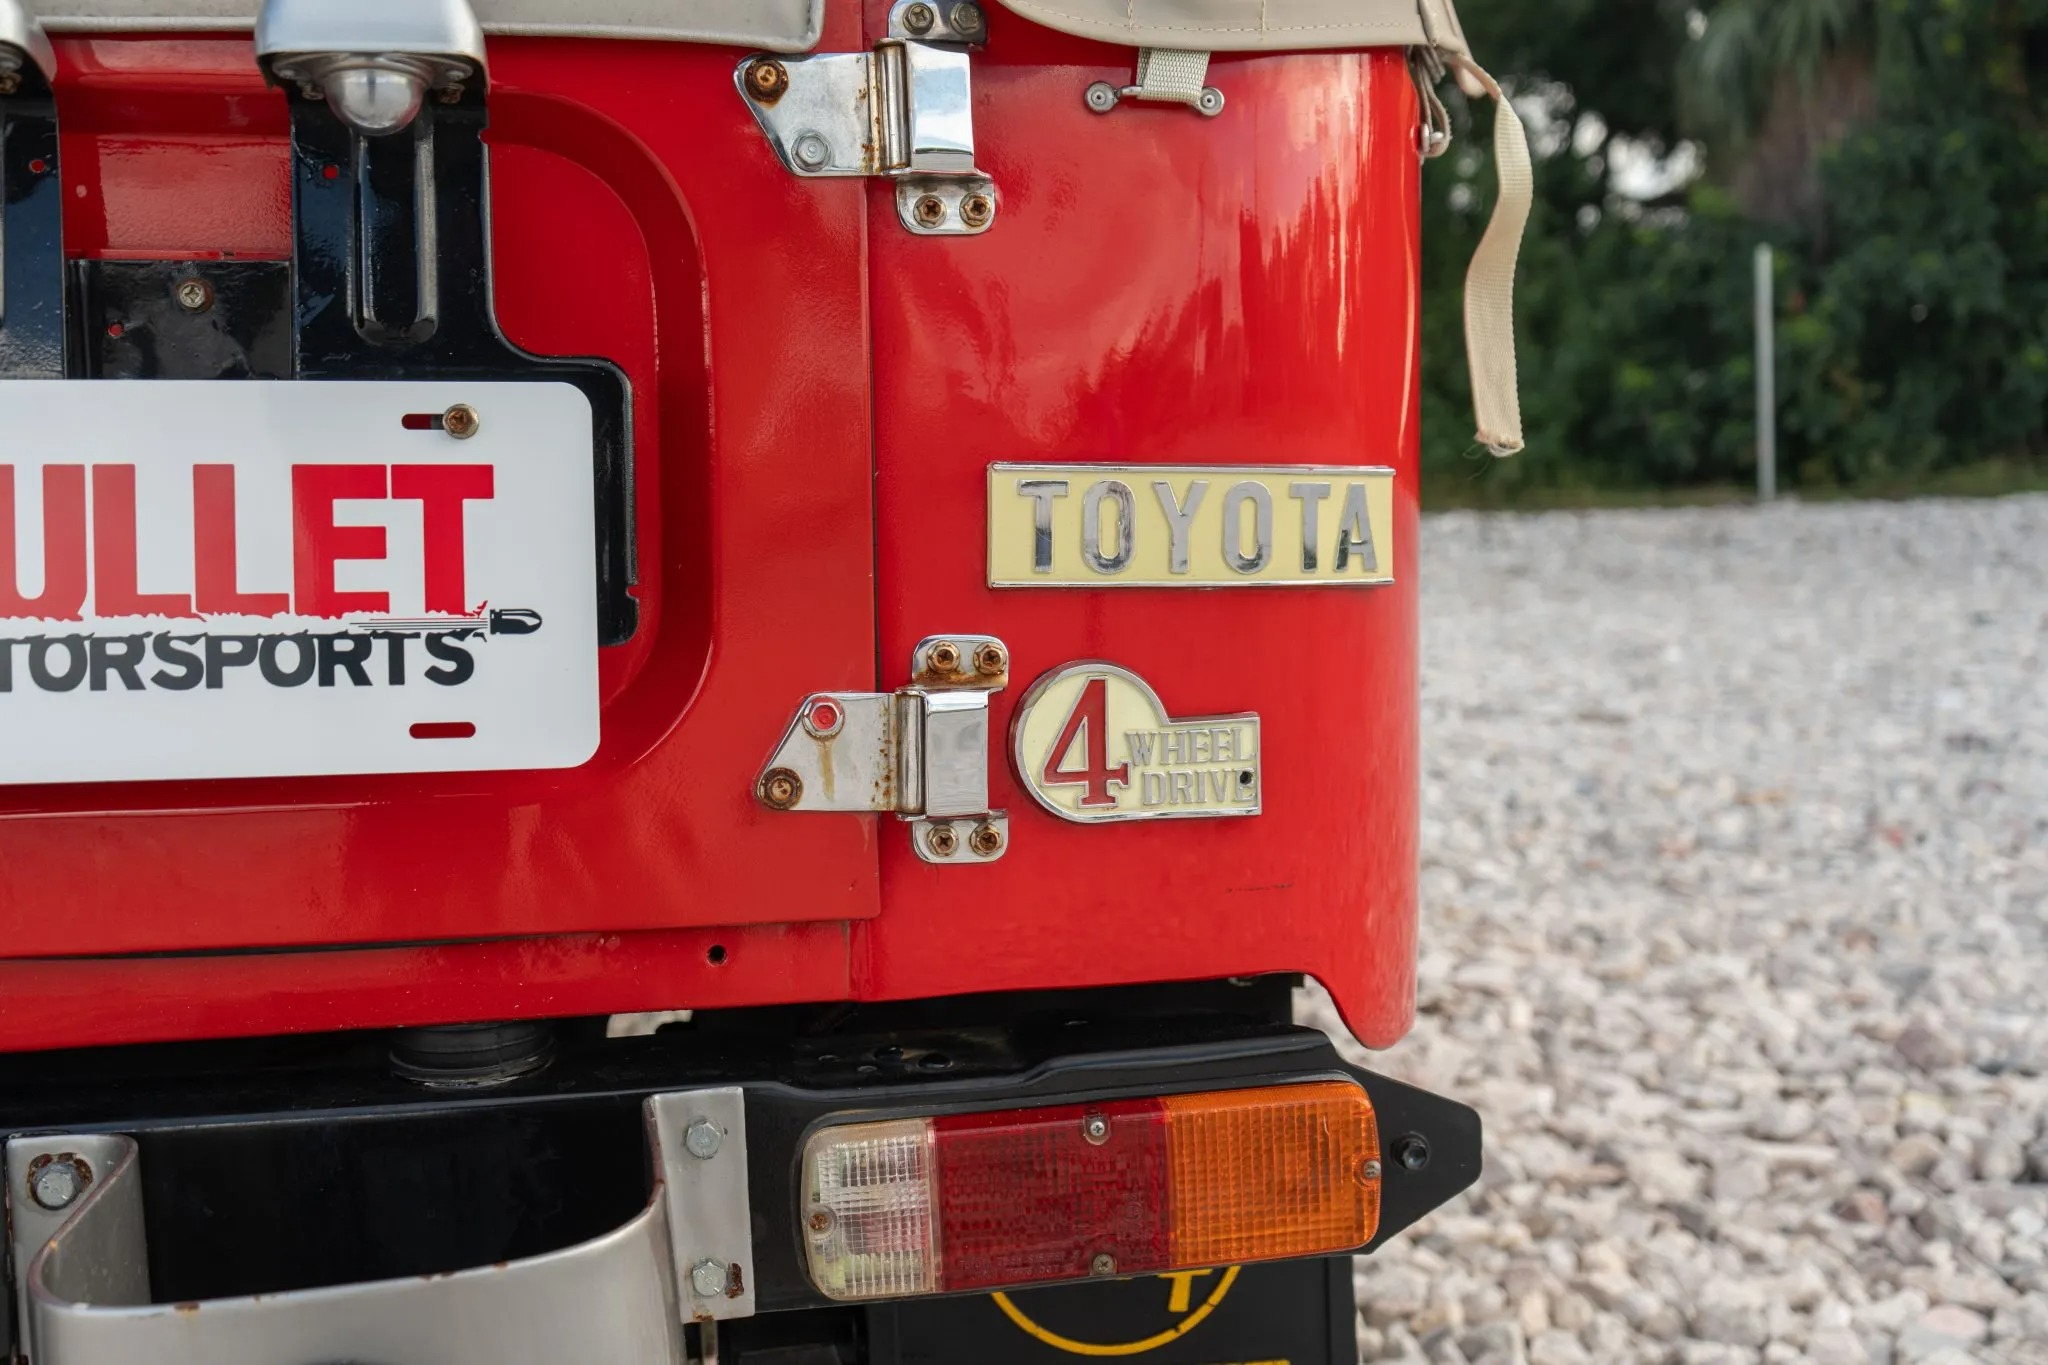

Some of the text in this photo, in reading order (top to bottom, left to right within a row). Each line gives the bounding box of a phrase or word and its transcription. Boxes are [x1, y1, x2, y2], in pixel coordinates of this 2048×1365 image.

[0, 463, 494, 622] ULLET
[1016, 479, 1378, 575] TOYOTA
[1040, 675, 1131, 810] 4
[1125, 727, 1257, 767] WHEEL
[1143, 767, 1257, 806] DRIVE
